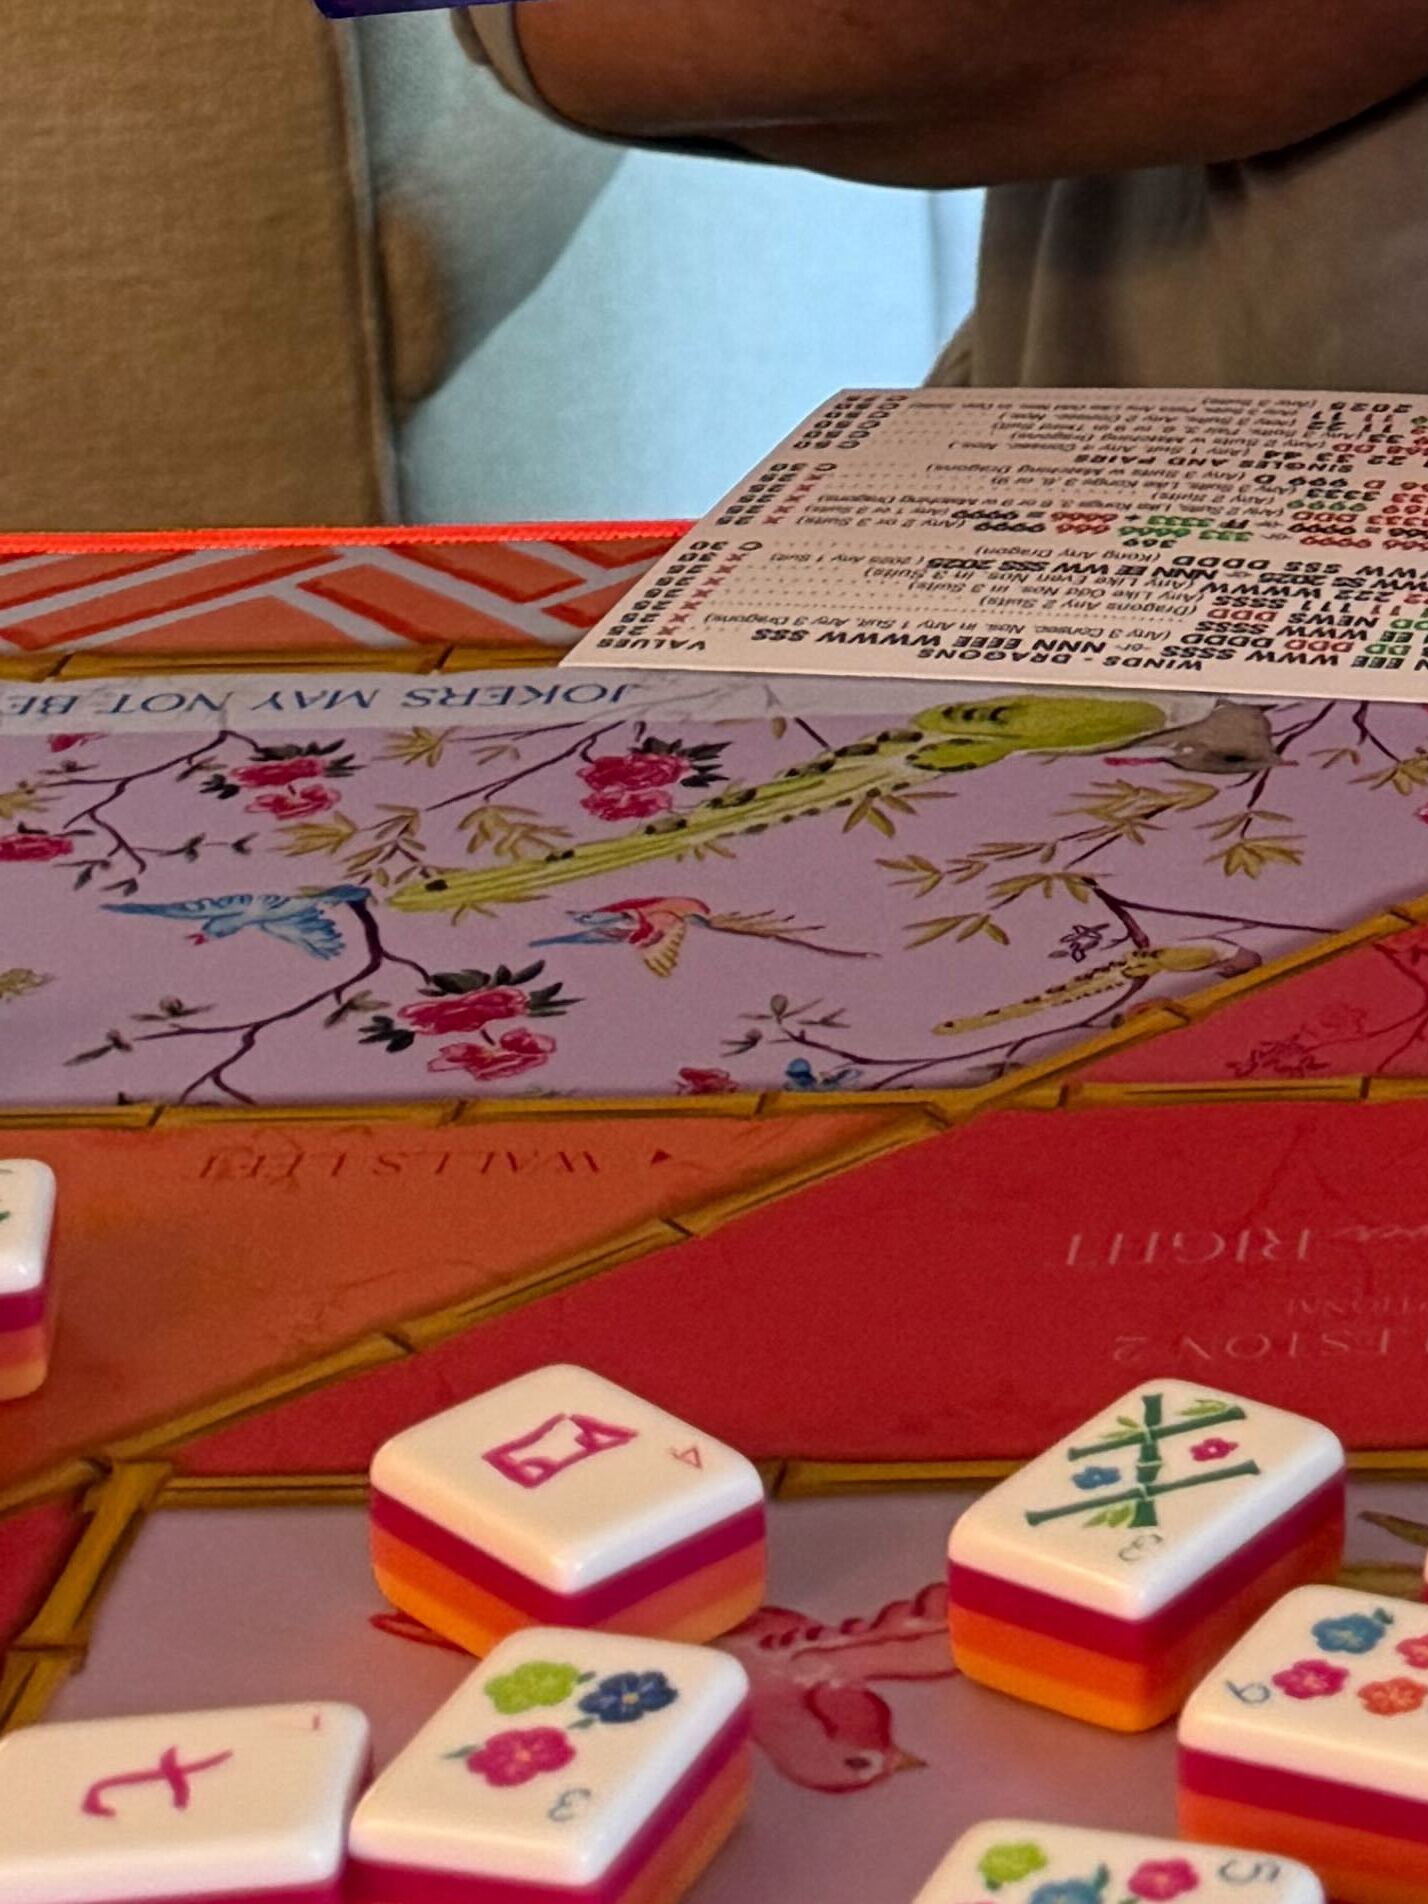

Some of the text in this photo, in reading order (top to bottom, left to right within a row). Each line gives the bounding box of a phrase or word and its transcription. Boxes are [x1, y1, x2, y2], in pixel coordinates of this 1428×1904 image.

[1074, 454, 1354, 473] SINGLES AND PAIRS
[1207, 609, 1277, 622] DDD
[1287, 613, 1378, 627] NEWS
[752, 628, 809, 642] SSS
[815, 631, 940, 646] WWWW
[954, 635, 1022, 649] EEEE
[596, 638, 706, 651] VALUES
[1032, 638, 1106, 652] NNN
[916, 648, 1072, 664] DRAGONS
[1162, 646, 1236, 660] SSSS
[1246, 650, 1339, 666] WWW
[1102, 655, 1202, 671] WINDS
[1351, 655, 1403, 669] EEE
[95, 689, 233, 715] NOT
[252, 686, 382, 713] MAY
[399, 683, 636, 708] JOKERS
[1044, 1225, 1312, 1267] RIGHT
[1112, 1334, 1148, 1363] 2
[1117, 1533, 1162, 1564] 3
[547, 1788, 591, 1823] 3
[1218, 1857, 1280, 1886] 5
